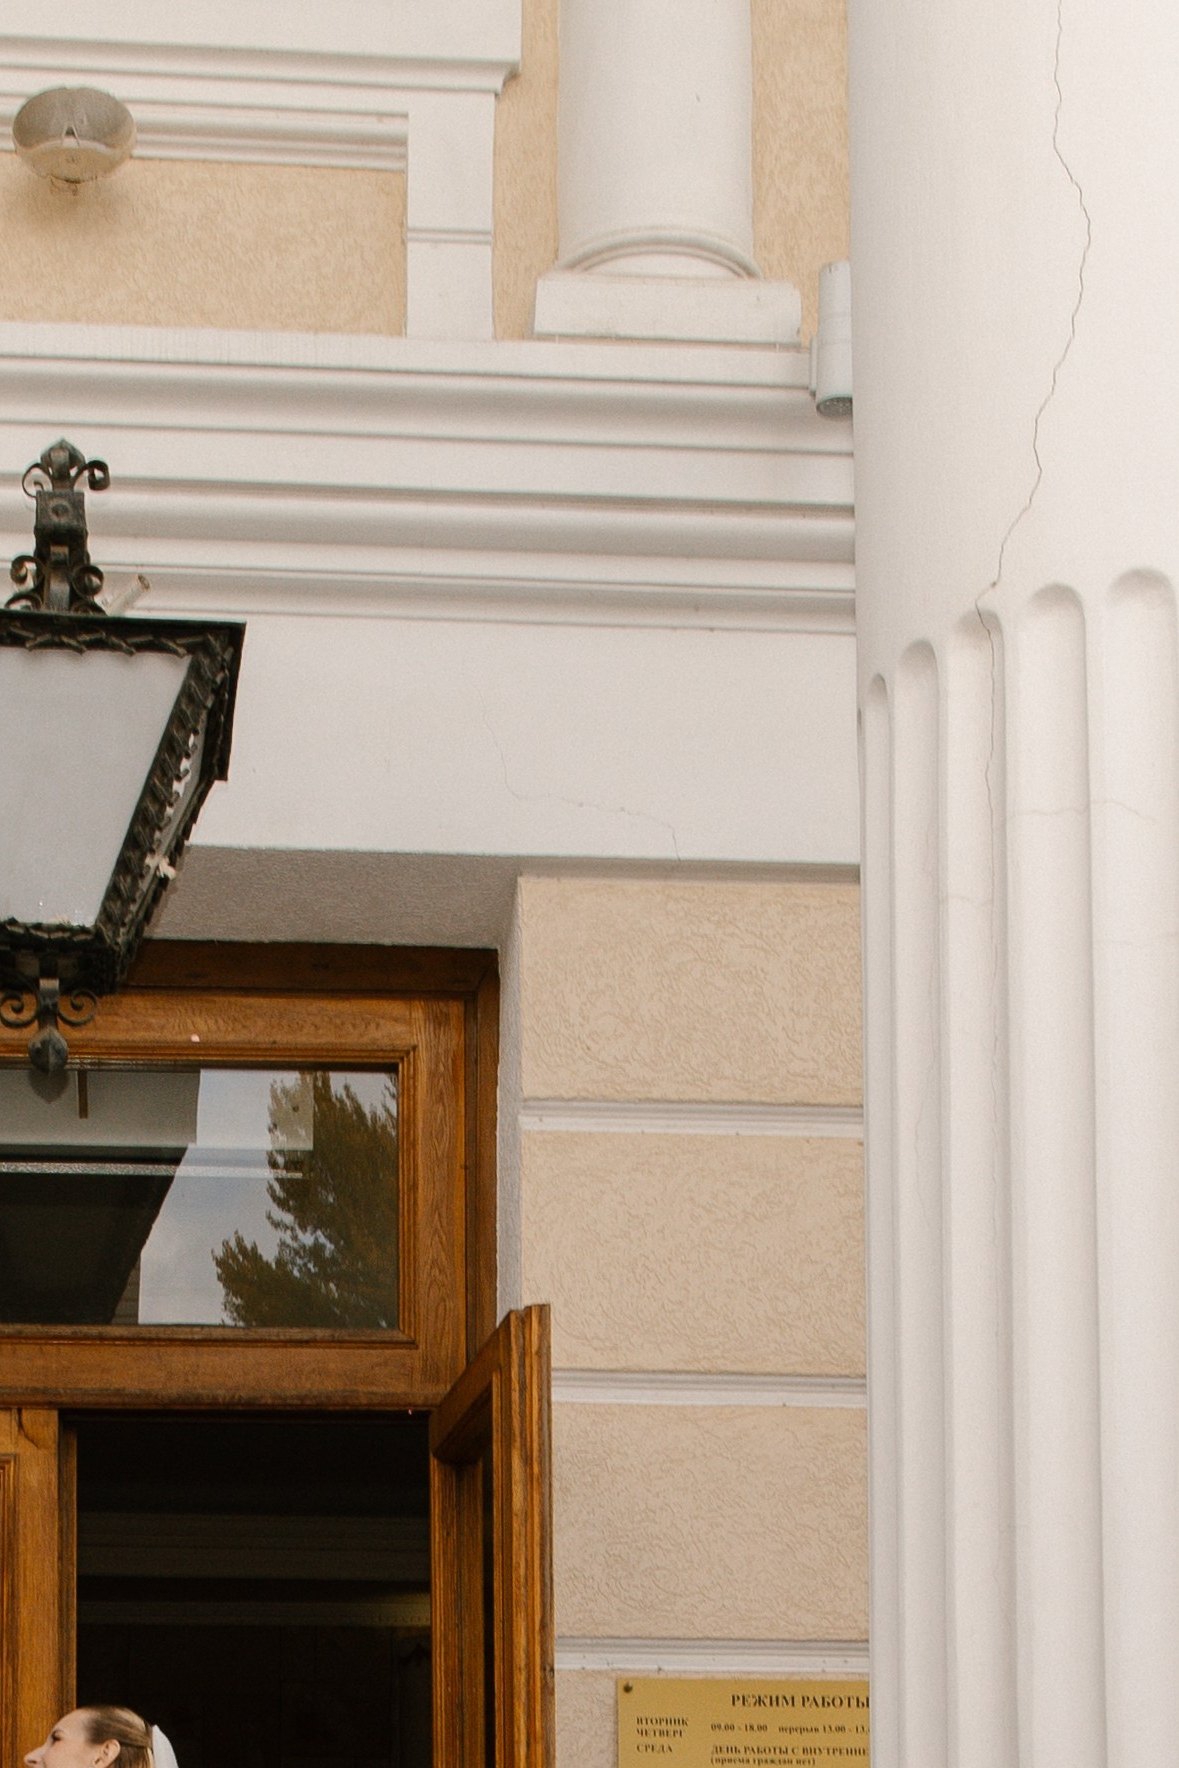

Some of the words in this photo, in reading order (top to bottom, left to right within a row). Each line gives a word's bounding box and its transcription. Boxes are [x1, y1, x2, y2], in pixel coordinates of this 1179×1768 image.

[732, 1695, 795, 1707] РЕЖИМ
[802, 1696, 870, 1708] РАБОТЫ
[637, 1717, 688, 1726] ВТОРНИК
[637, 1729, 684, 1737] ЧЕТВЕРГ
[745, 1724, 767, 1732] 18.00
[823, 1725, 845, 1733] 13.00
[637, 1744, 672, 1753] СРЕДА
[712, 1745, 740, 1755] ДЕНЬ
[744, 1746, 788, 1755] РАБОТЫ
[792, 1747, 799, 1755] С
[753, 1758, 793, 1766] граждан
[796, 1758, 815, 1766] нет)
